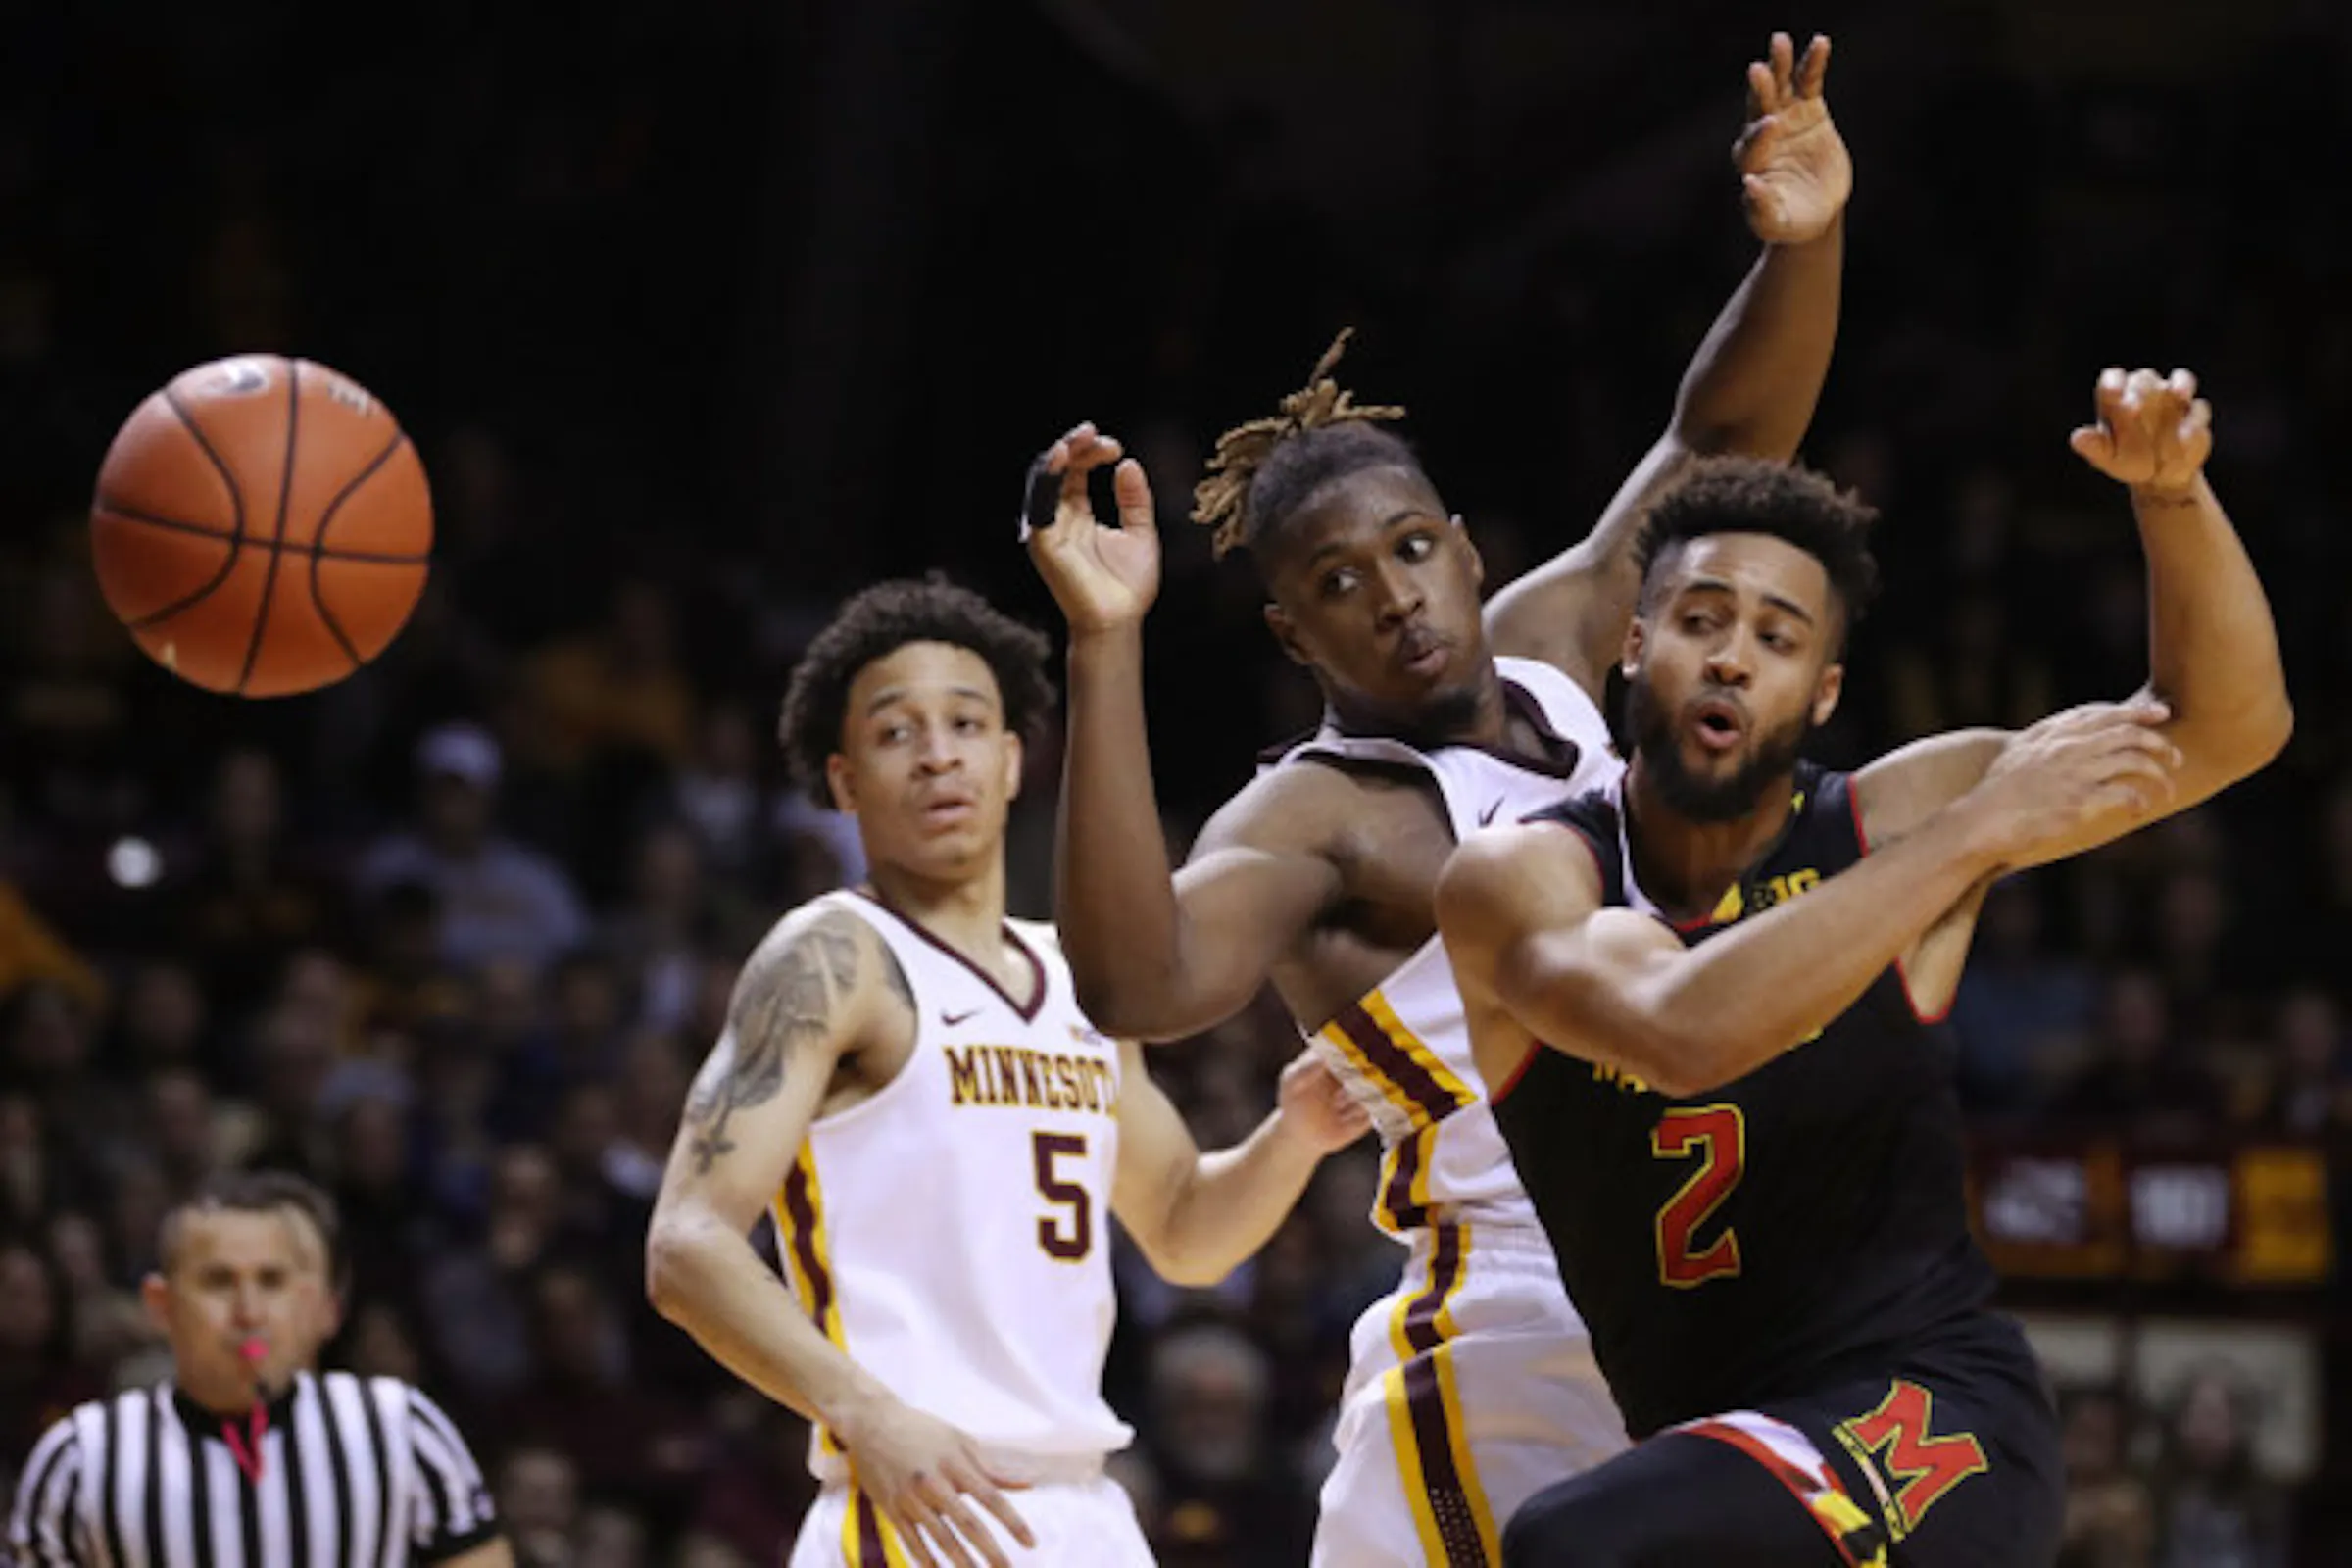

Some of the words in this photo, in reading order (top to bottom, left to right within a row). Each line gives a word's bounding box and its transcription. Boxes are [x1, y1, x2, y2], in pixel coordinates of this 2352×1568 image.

[1030, 1130, 1093, 1263] 5
[1650, 1102, 1745, 1290] 2
[1841, 1377, 1989, 1534] M
